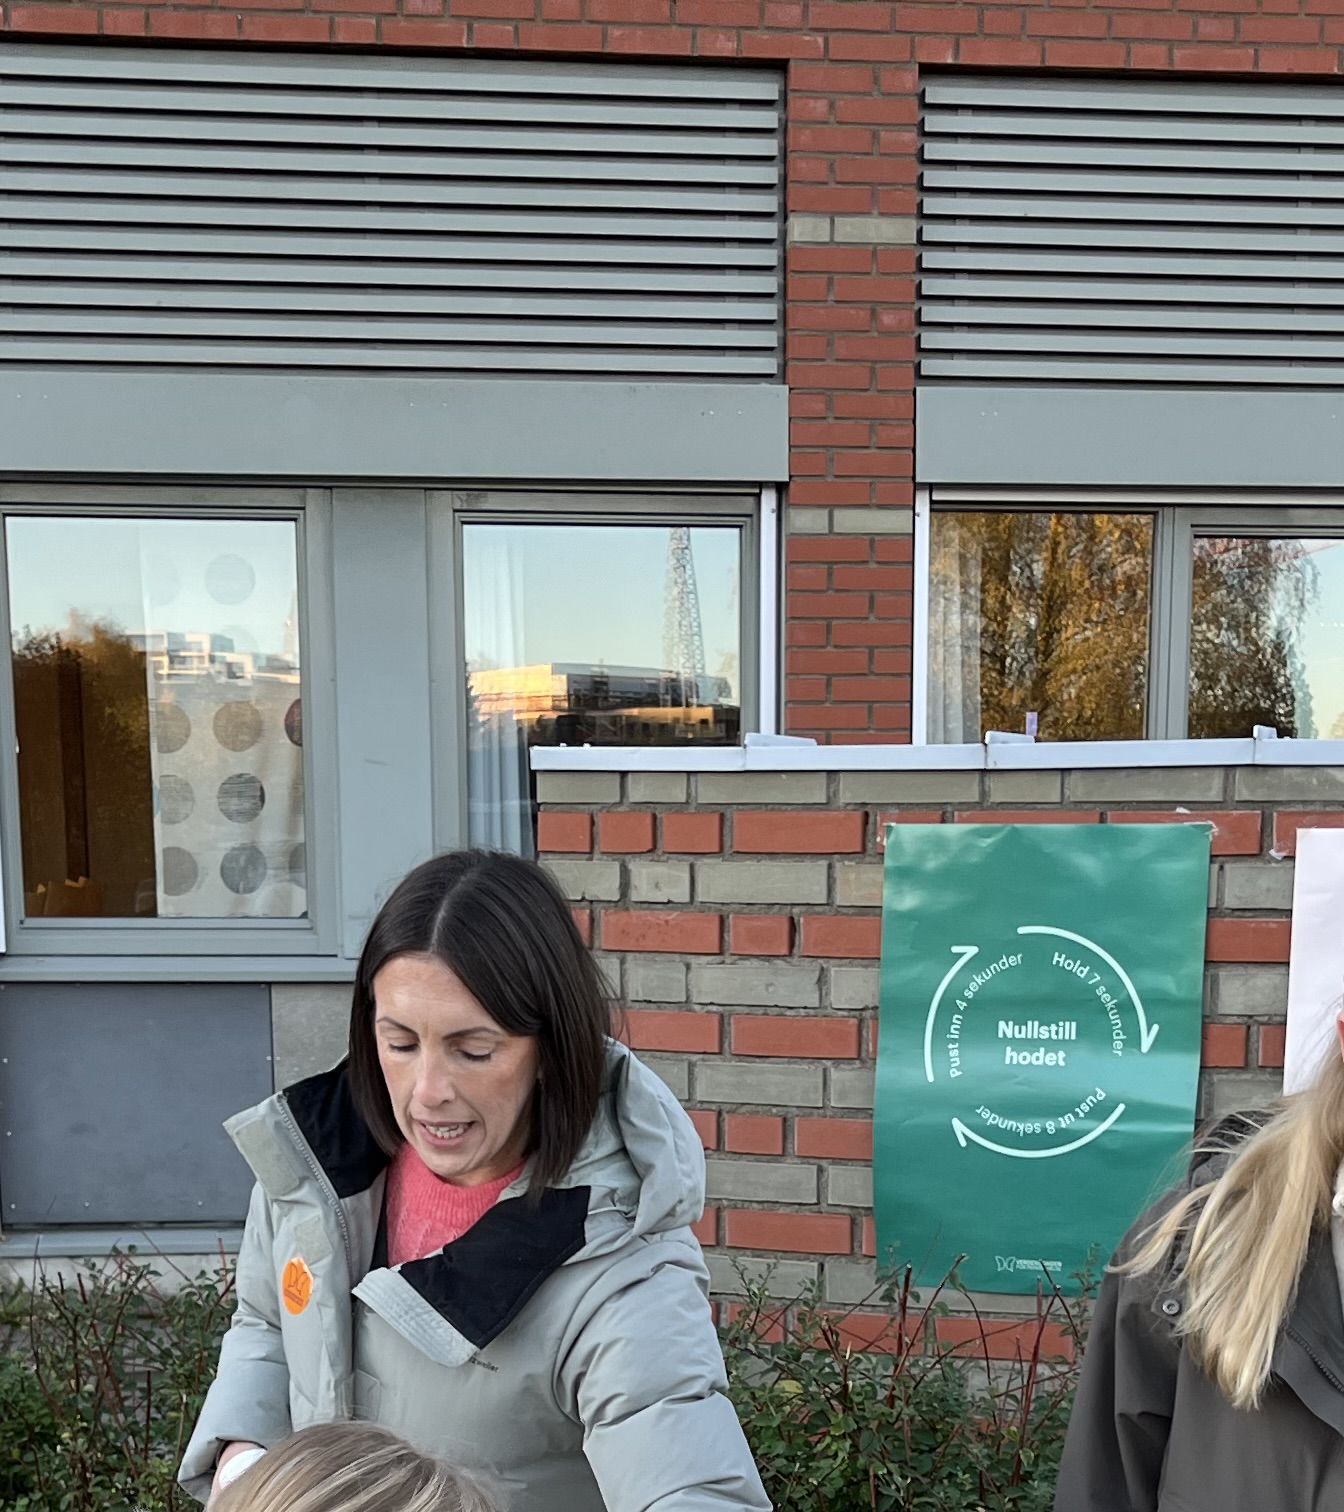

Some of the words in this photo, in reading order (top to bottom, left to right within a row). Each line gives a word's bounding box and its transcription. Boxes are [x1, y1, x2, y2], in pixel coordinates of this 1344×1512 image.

[963, 953, 1023, 999] sekunder
[956, 999, 968, 1011] 4
[1052, 952, 1090, 979] Hold
[1087, 972, 1101, 985] 7
[1096, 985, 1127, 1057] sekunder
[946, 1014, 963, 1039] inn
[997, 1020, 1077, 1041] Nullstill
[948, 1042, 963, 1078] Pust
[1005, 1046, 1066, 1067] hodet
[1074, 1087, 1107, 1118] Pust
[975, 1105, 1042, 1137] sekunder
[1045, 1120, 1056, 1135] 8
[1058, 1113, 1076, 1129] ut
